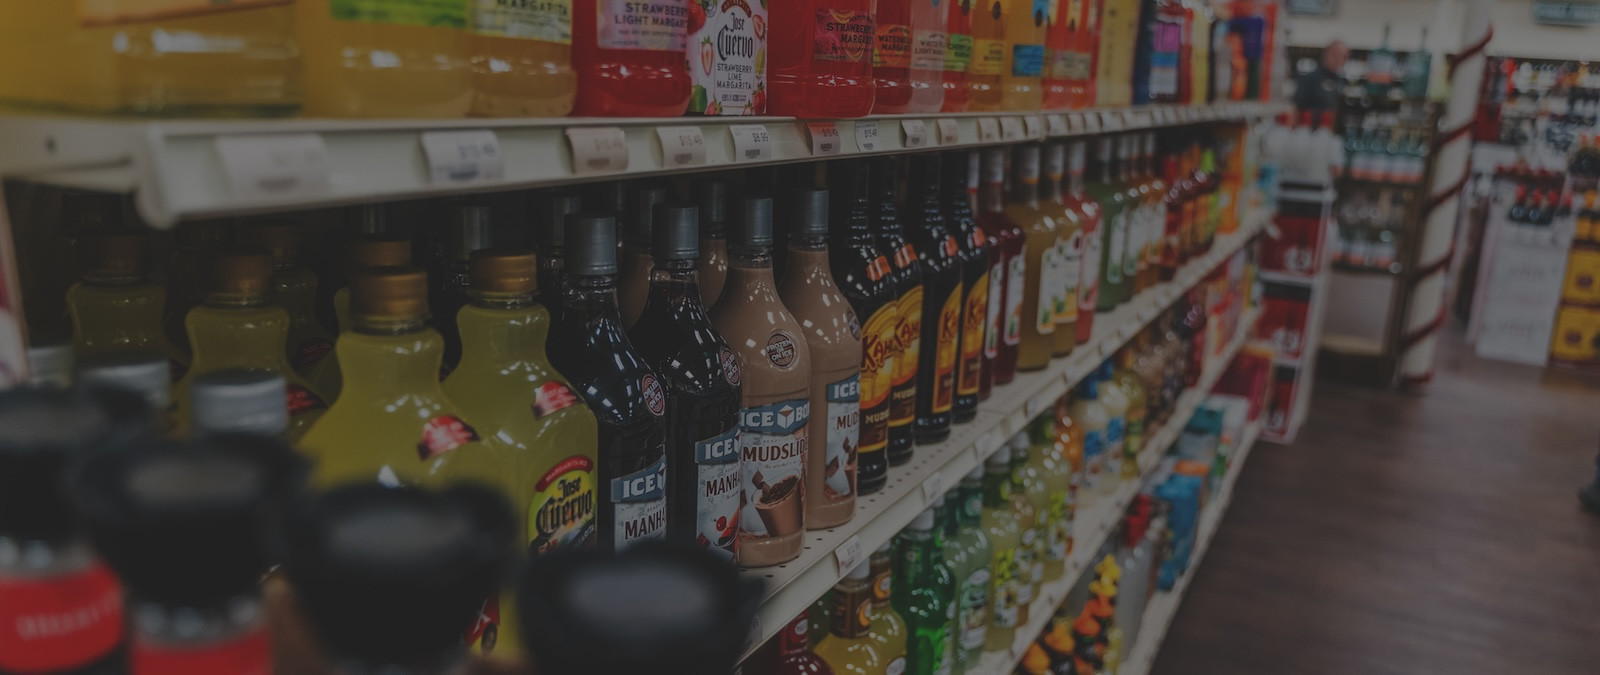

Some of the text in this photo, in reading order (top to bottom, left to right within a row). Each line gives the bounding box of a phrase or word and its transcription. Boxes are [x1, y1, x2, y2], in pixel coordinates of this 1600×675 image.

[615, 15, 648, 26] LIGHT
[717, 24, 754, 61] Cuervo
[717, 63, 752, 73] STRAWBERRY
[728, 72, 742, 81] LIME
[716, 81, 752, 90] MARGARITA
[766, 340, 793, 353] FROZEN
[833, 381, 856, 399] ICE
[741, 411, 775, 427] ICE
[705, 437, 733, 460] ICE
[623, 473, 656, 499] ICE
[536, 489, 593, 537] Cuervo
